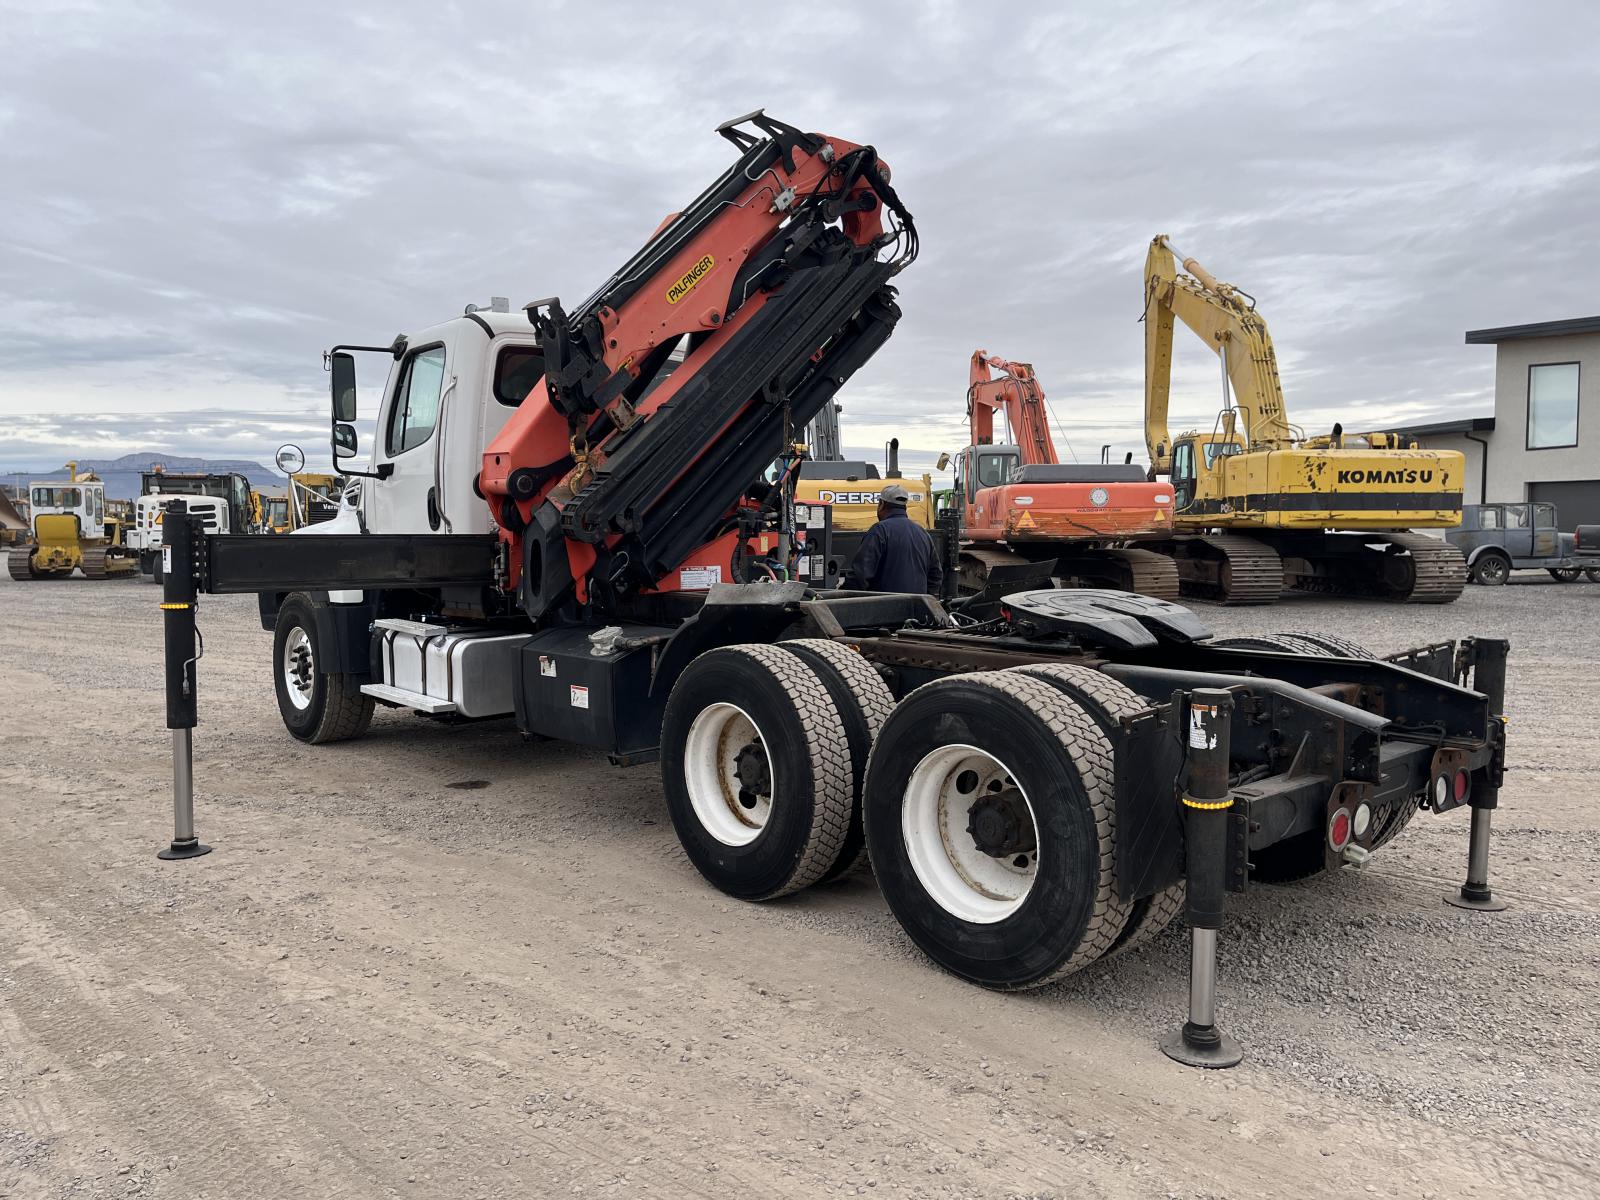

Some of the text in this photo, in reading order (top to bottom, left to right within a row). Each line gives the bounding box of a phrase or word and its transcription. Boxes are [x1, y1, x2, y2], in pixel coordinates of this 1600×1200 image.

[668, 256, 712, 301] PALFINGER
[1338, 470, 1432, 483] KOMATSU
[819, 490, 880, 504] DEERE
